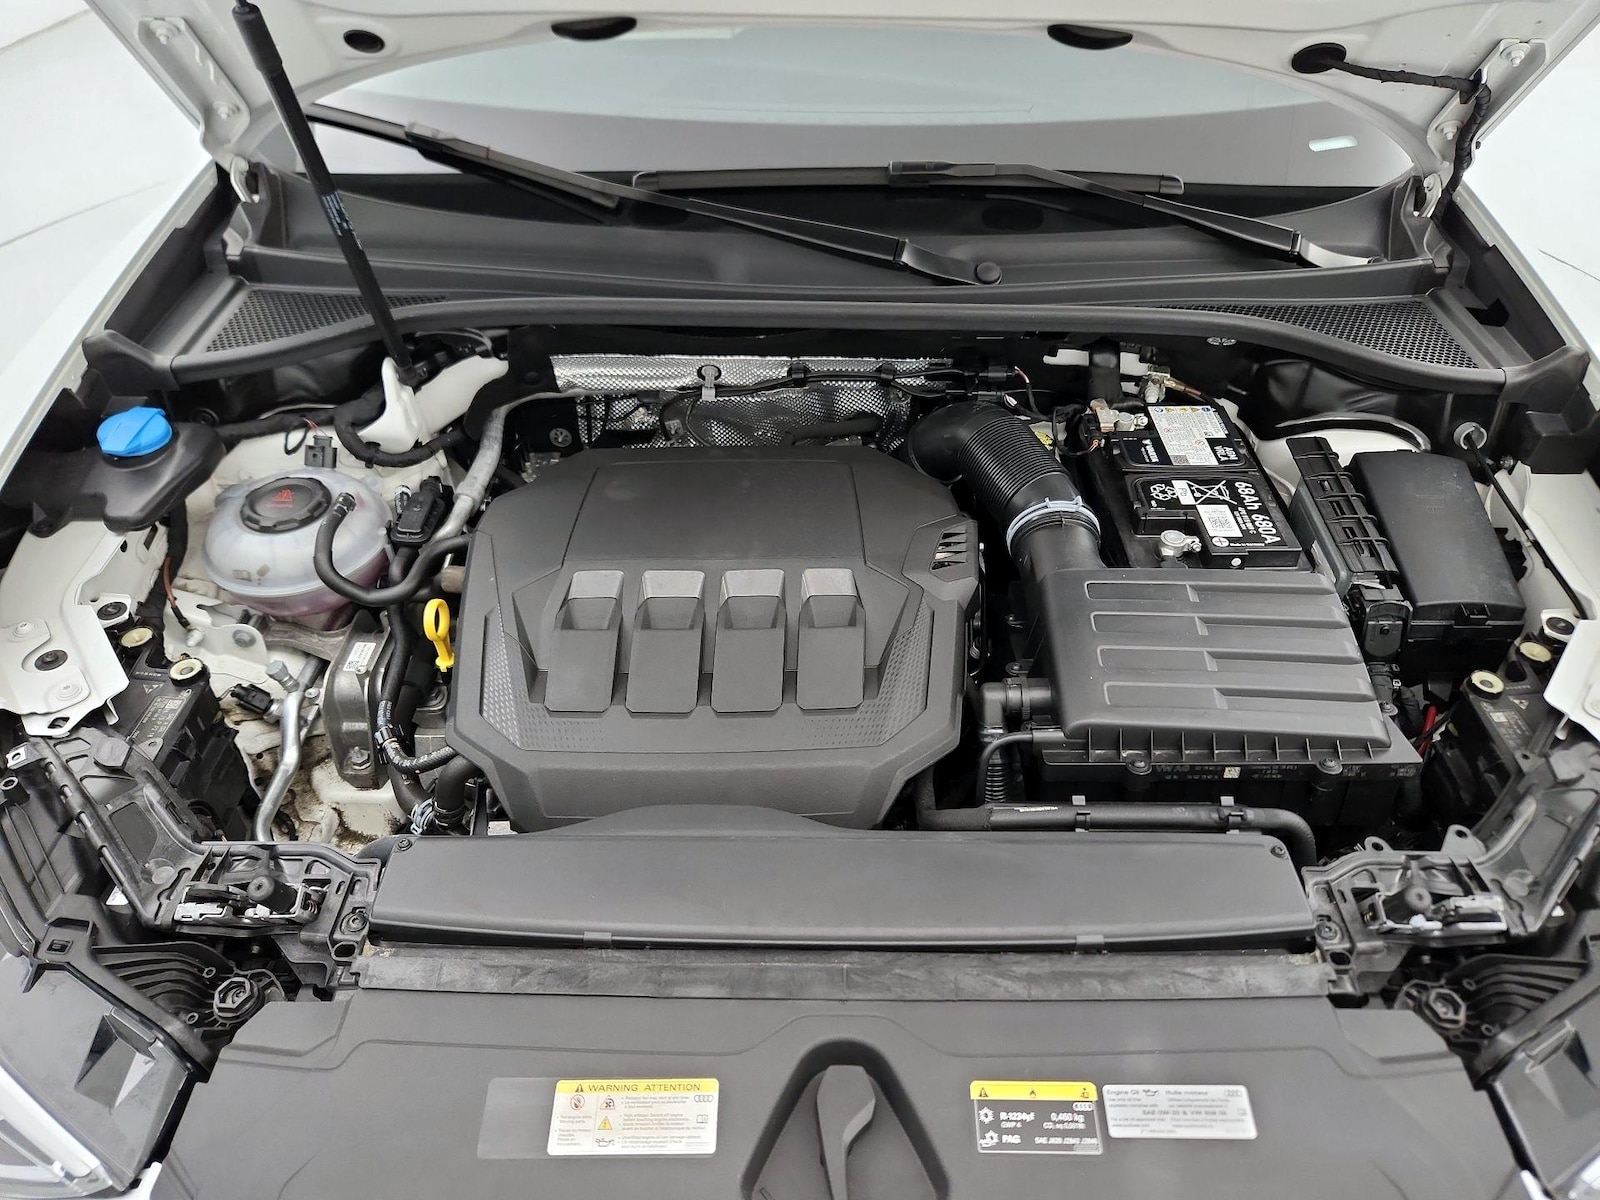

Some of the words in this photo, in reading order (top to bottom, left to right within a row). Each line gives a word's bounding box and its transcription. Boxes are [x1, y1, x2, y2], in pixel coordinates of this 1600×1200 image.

[1213, 445, 1228, 462] VRLA
[1234, 481, 1262, 510] 68Ah
[1251, 513, 1281, 544] 680A
[588, 1084, 638, 1093] WARNING
[644, 1083, 701, 1091] ATTENTION
[1002, 1134, 1021, 1144] PAG
